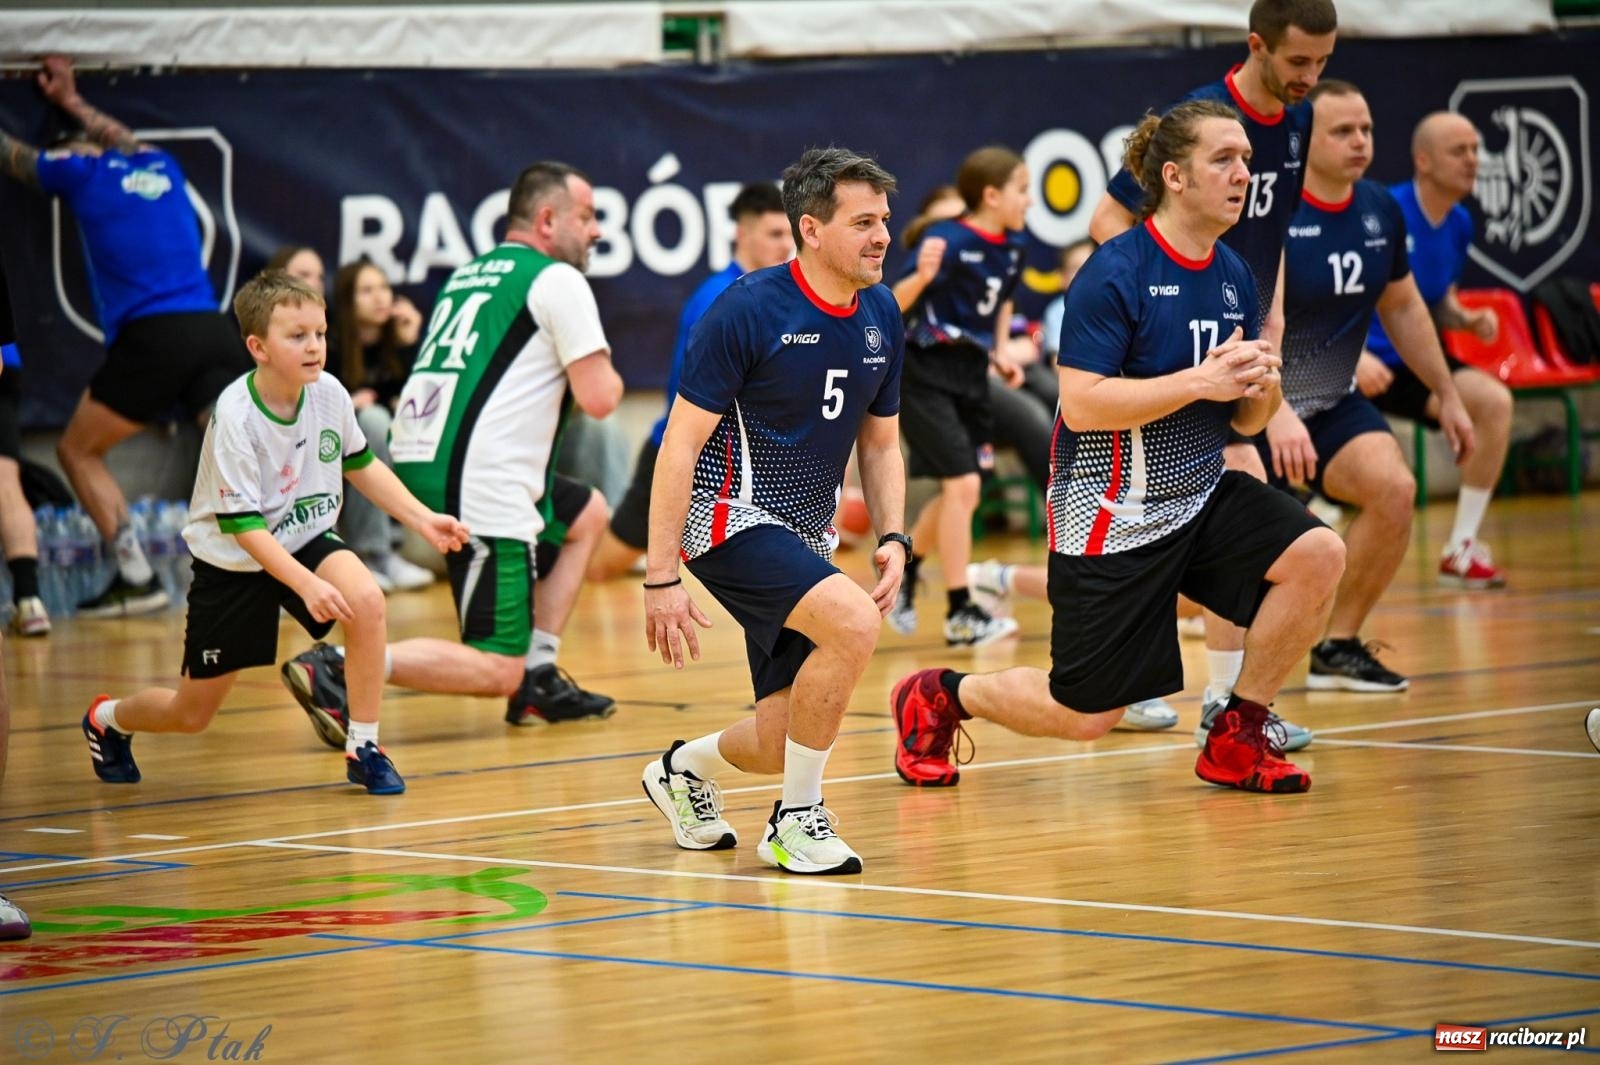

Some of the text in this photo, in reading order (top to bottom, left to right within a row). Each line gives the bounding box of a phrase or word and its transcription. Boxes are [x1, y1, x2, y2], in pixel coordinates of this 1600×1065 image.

[1247, 172, 1278, 219] 13
[976, 276, 1002, 316] 3
[1327, 251, 1365, 295] 12
[412, 292, 492, 371] 24
[821, 369, 849, 420] 5
